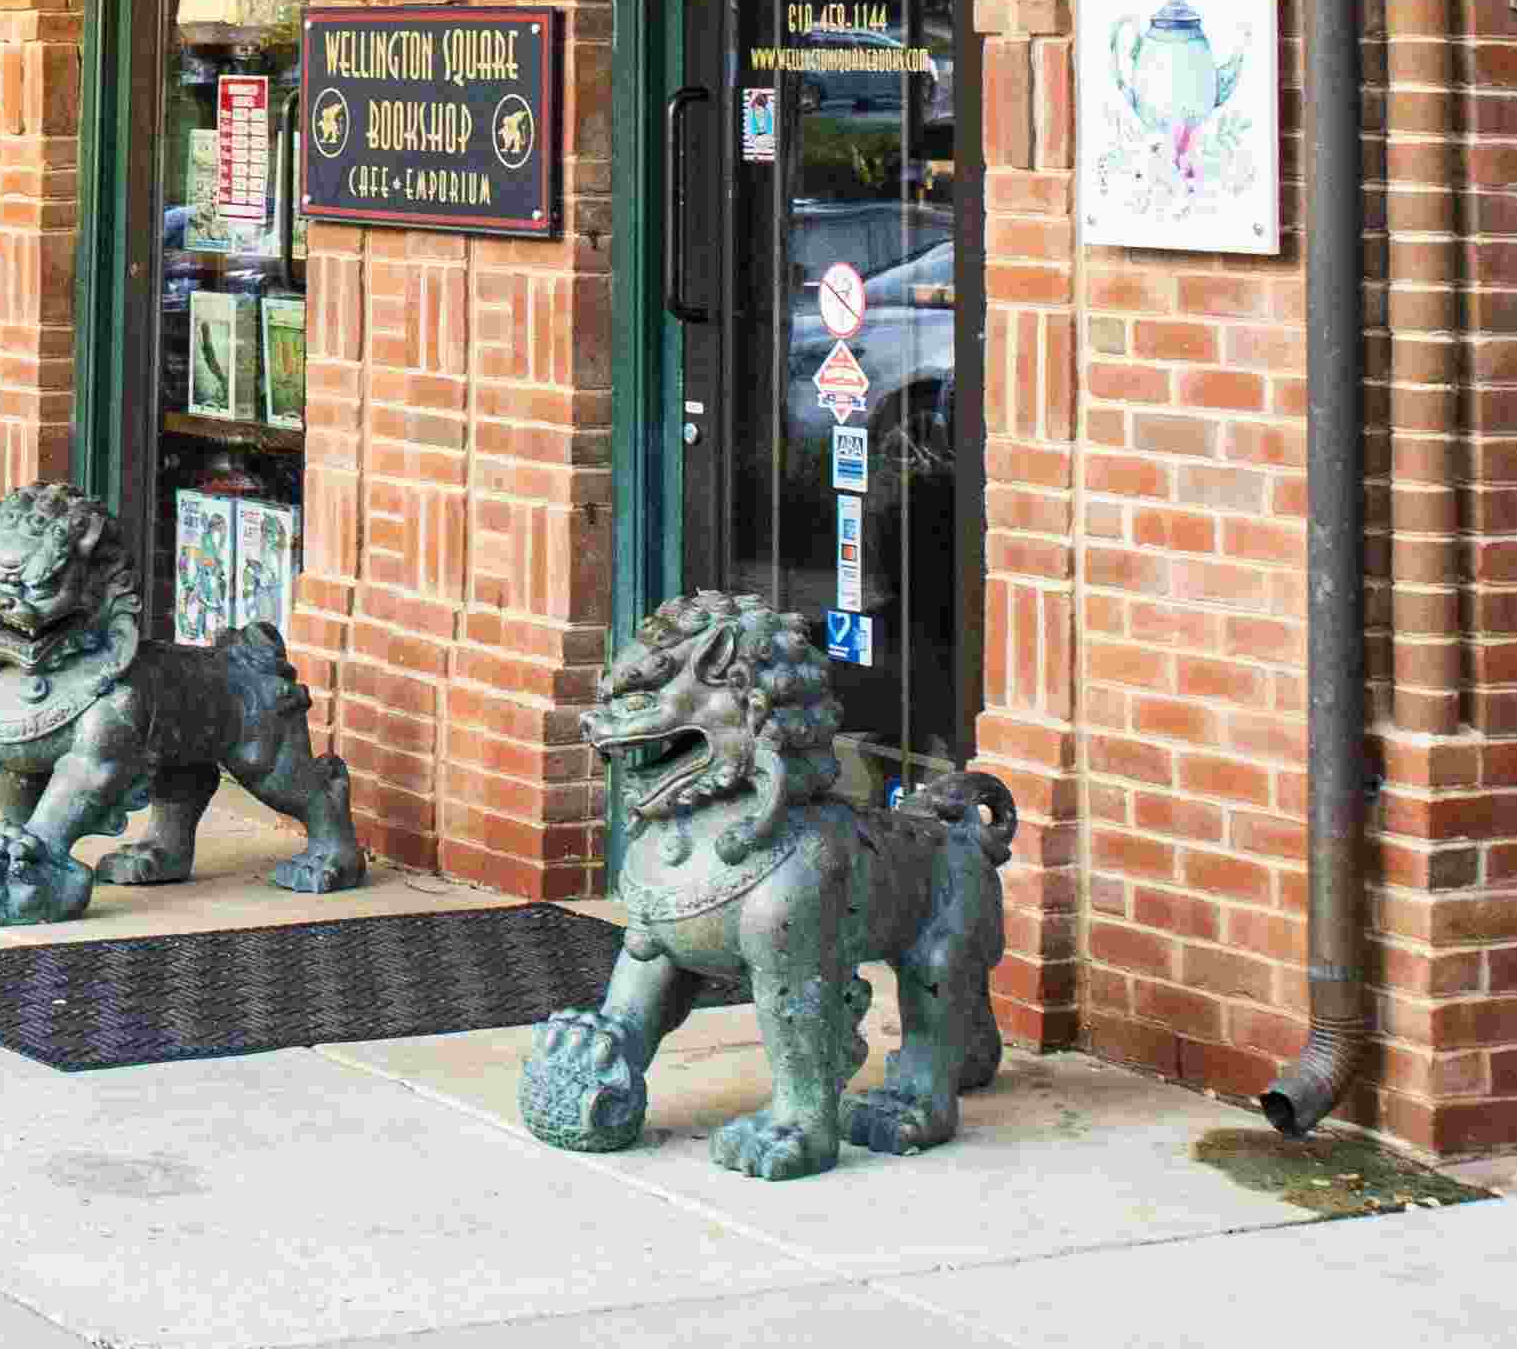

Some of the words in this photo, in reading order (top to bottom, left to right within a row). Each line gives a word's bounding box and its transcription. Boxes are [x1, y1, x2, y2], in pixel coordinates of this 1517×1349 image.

[324, 30, 434, 80] WELLINGTON
[443, 29, 519, 86] SQUARE
[366, 101, 472, 154] BOOKSHOP
[349, 166, 389, 198] CAFE
[404, 168, 491, 205] EMPORIUM
